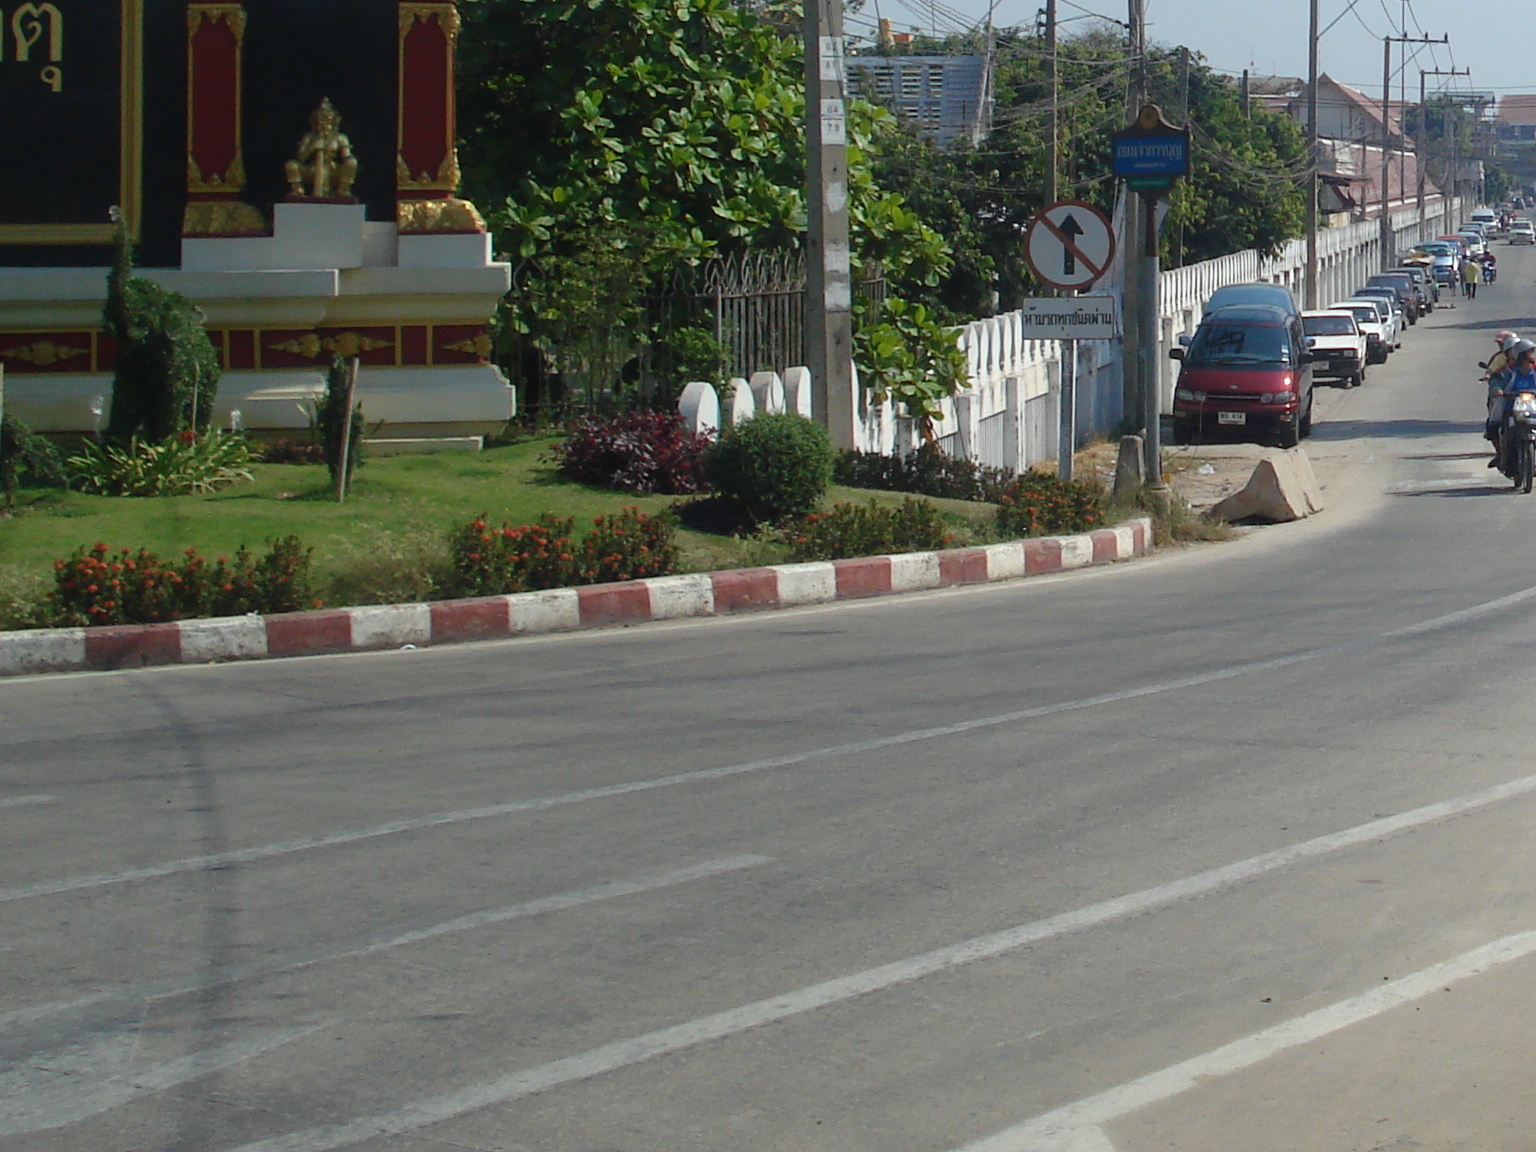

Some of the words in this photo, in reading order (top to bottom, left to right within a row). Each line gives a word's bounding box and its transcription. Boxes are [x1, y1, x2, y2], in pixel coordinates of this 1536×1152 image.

[0, 2, 63, 93] ตุ
[1024, 306, 1111, 331] ห้ามรถทุกชนิดผ่าน
